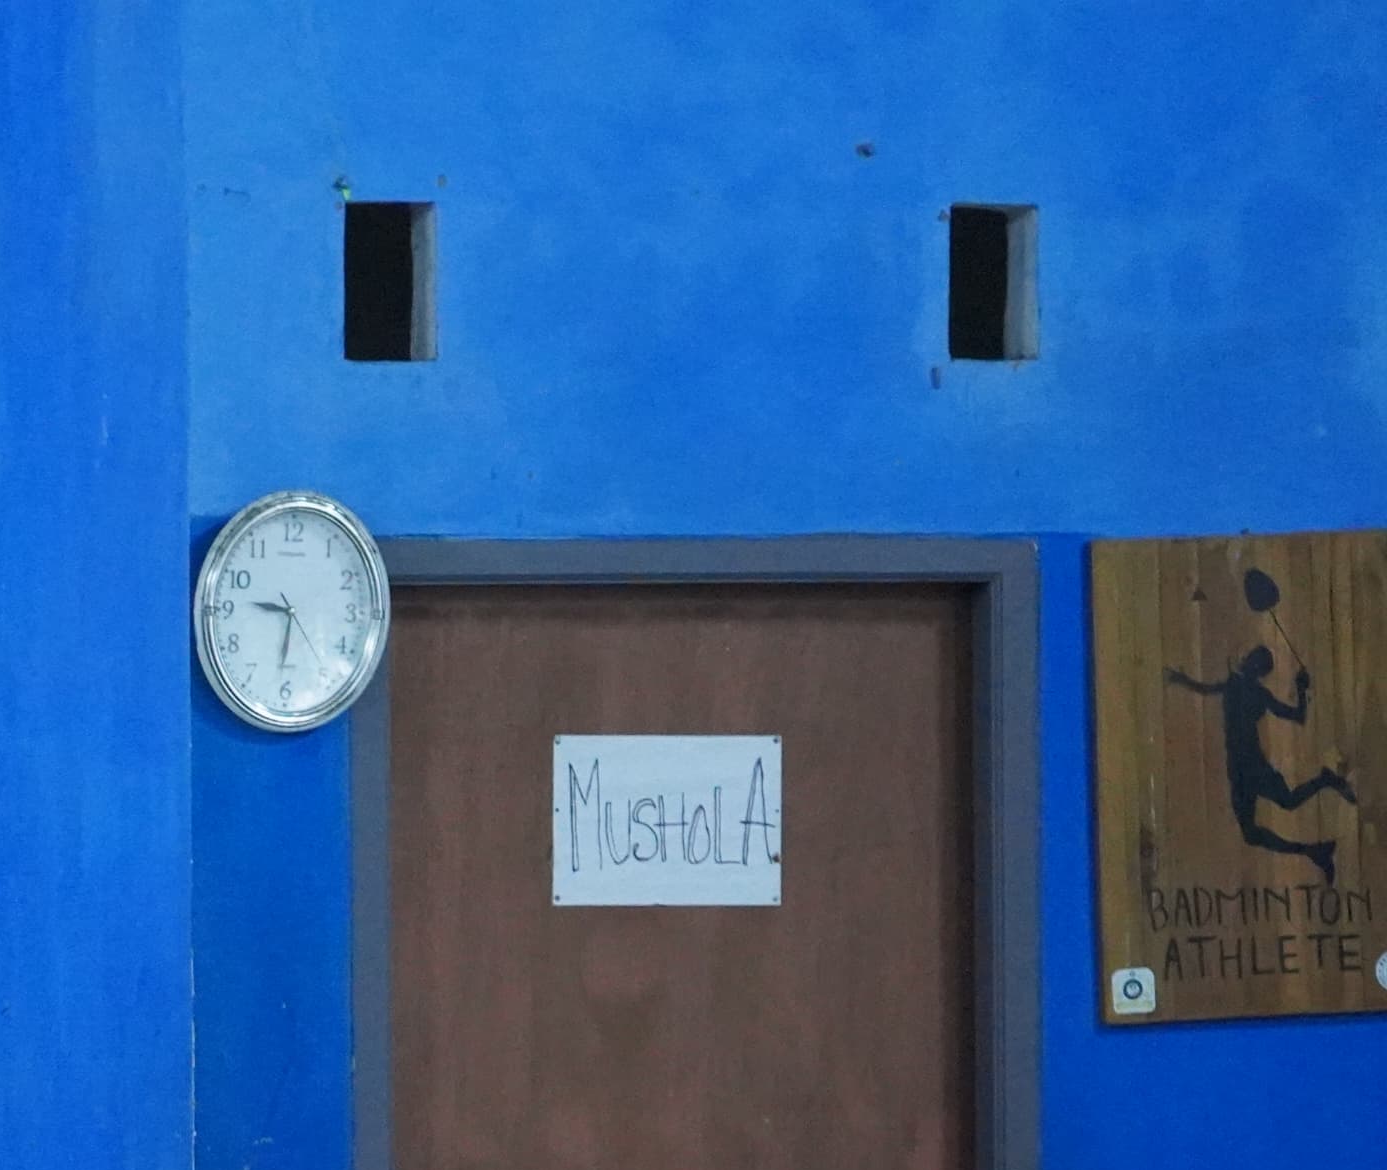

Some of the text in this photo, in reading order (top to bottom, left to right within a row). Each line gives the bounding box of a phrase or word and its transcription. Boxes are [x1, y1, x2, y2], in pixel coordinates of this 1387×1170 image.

[283, 522, 304, 543] 12
[250, 539, 266, 559] 11
[325, 539, 333, 558] 1
[229, 570, 251, 590] 10
[340, 570, 353, 590] 2
[222, 600, 235, 620] 9
[344, 604, 357, 624] 3
[227, 634, 240, 654] 8
[334, 635, 348, 655] 4
[245, 663, 257, 687] 7
[279, 681, 292, 700] 6
[568, 757, 776, 873] MUSHOLA
[1148, 884, 1373, 932] BADMINTON
[1164, 934, 1362, 981] ATHLETE
